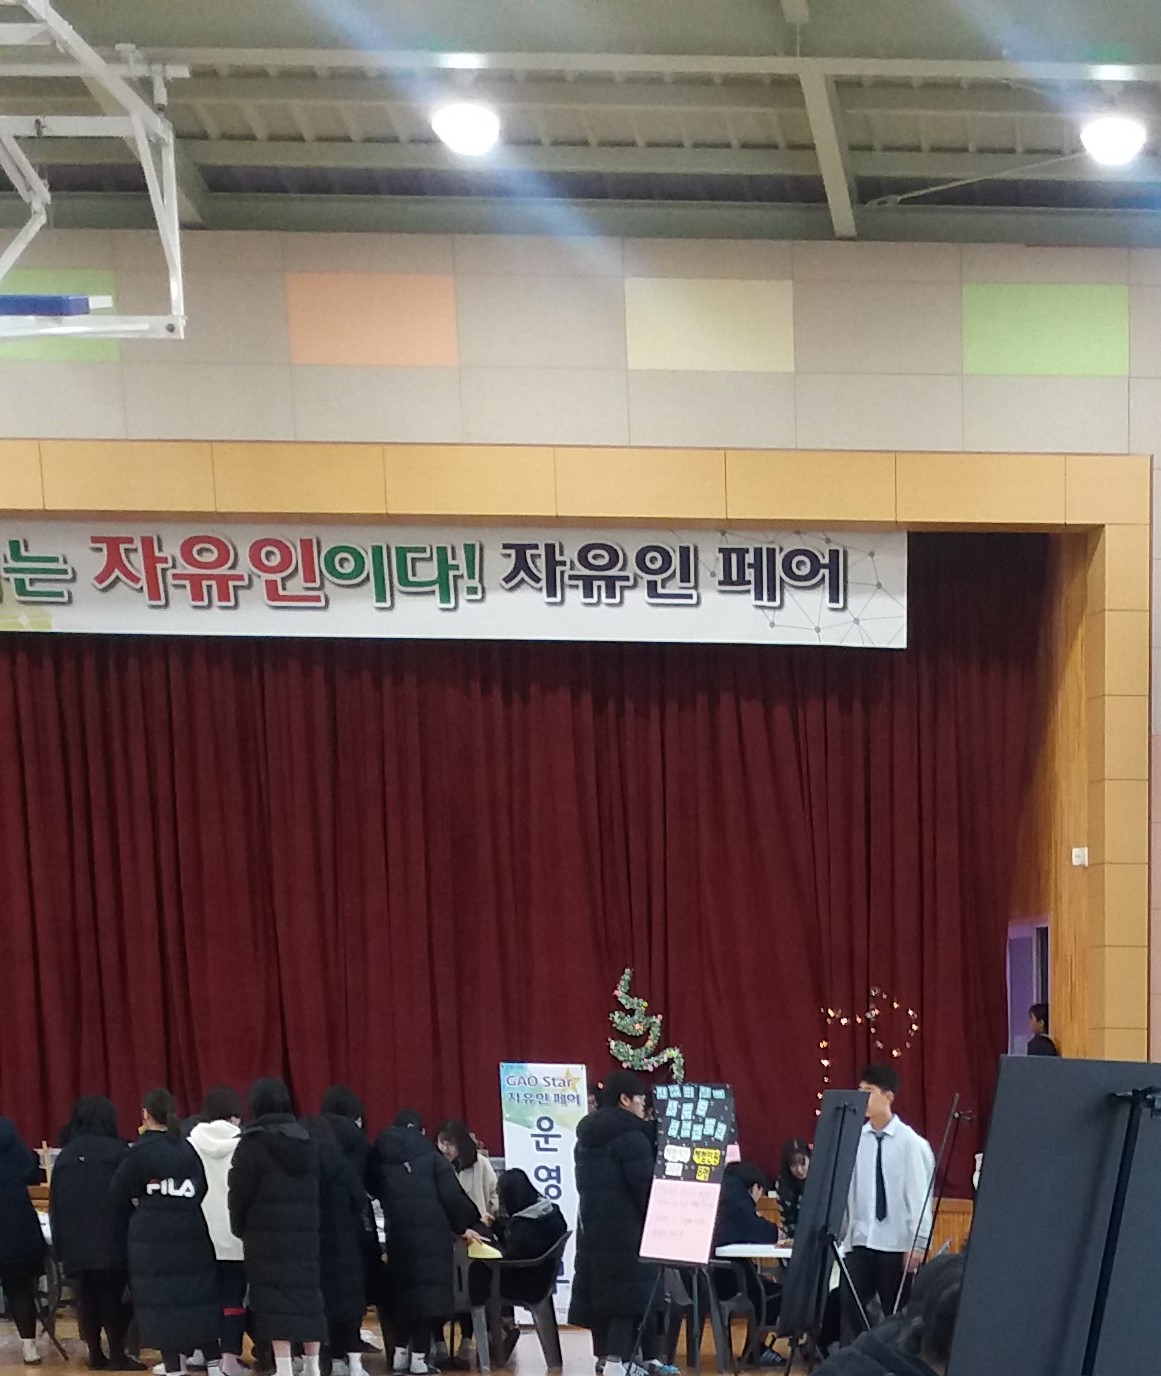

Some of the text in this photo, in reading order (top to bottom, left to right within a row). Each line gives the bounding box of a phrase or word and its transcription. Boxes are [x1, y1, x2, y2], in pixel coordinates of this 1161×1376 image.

[2, 534, 845, 609] 는 자유인이다! 자유인 페어
[506, 1074, 573, 1088] GAO Star
[507, 1092, 550, 1106] 자유인
[146, 1178, 195, 1198] FILA
